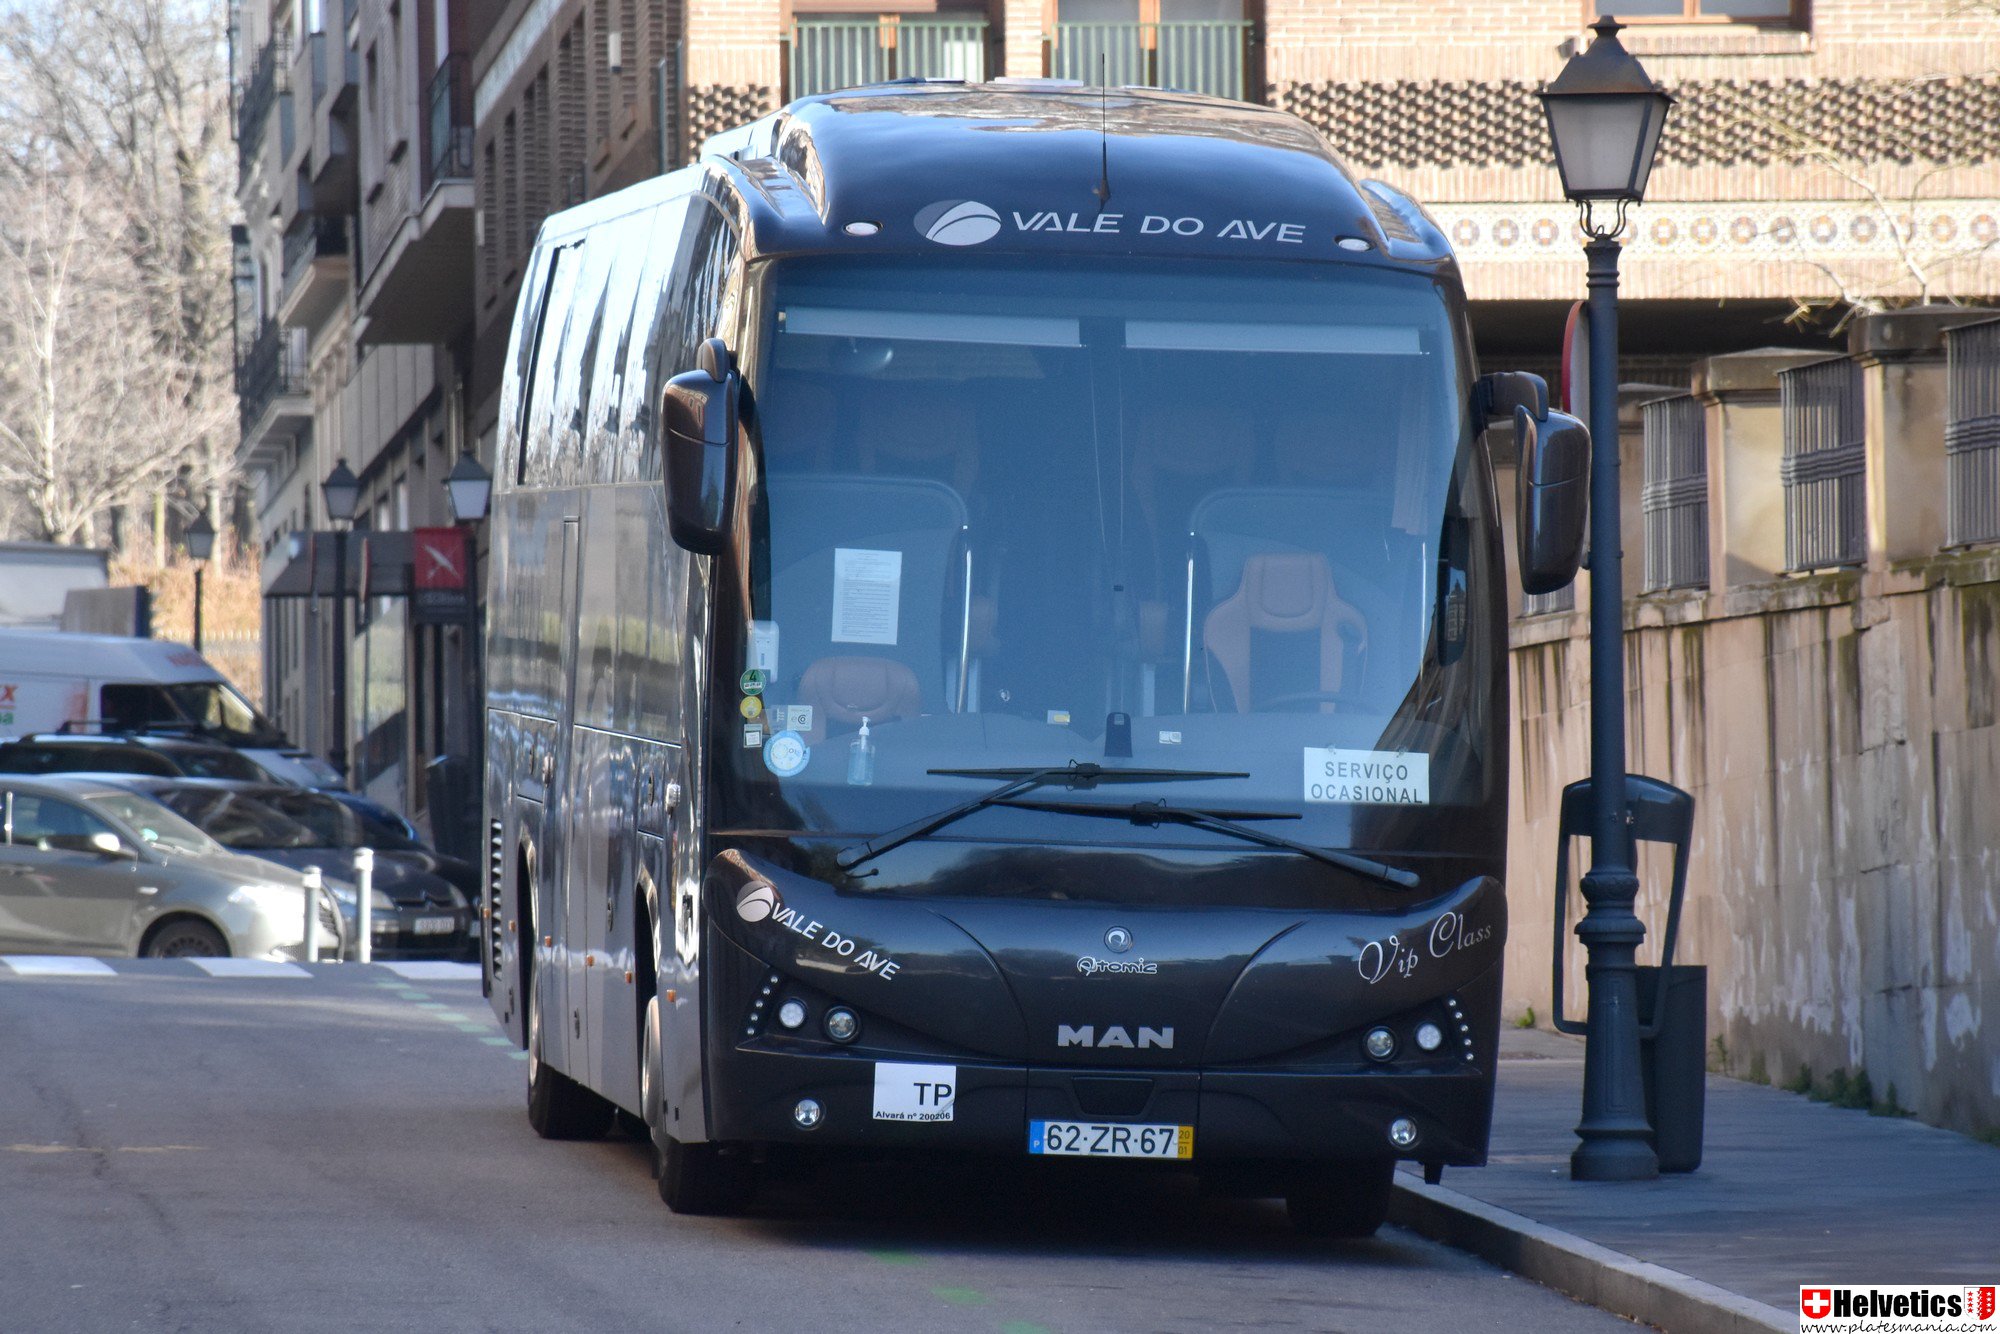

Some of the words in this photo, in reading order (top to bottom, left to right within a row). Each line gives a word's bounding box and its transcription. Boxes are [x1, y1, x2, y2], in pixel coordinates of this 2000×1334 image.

[1012, 211, 1124, 233] VALE
[1140, 215, 1204, 236] DO
[1216, 219, 1306, 243] AVE
[1325, 761, 1408, 784] SERVIÇO
[1311, 783, 1423, 804] OCASIONAL
[771, 903, 823, 940] VALE
[822, 931, 855, 956] DO
[853, 950, 901, 981] AVE
[1358, 935, 1419, 984] Vip
[1429, 912, 1492, 958] Class
[1057, 1024, 1174, 1049] MAN
[913, 1083, 952, 1106] TP
[875, 1111, 904, 1120] Alvará
[920, 1112, 951, 1120] 200206
[1178, 1130, 1190, 1139] 20
